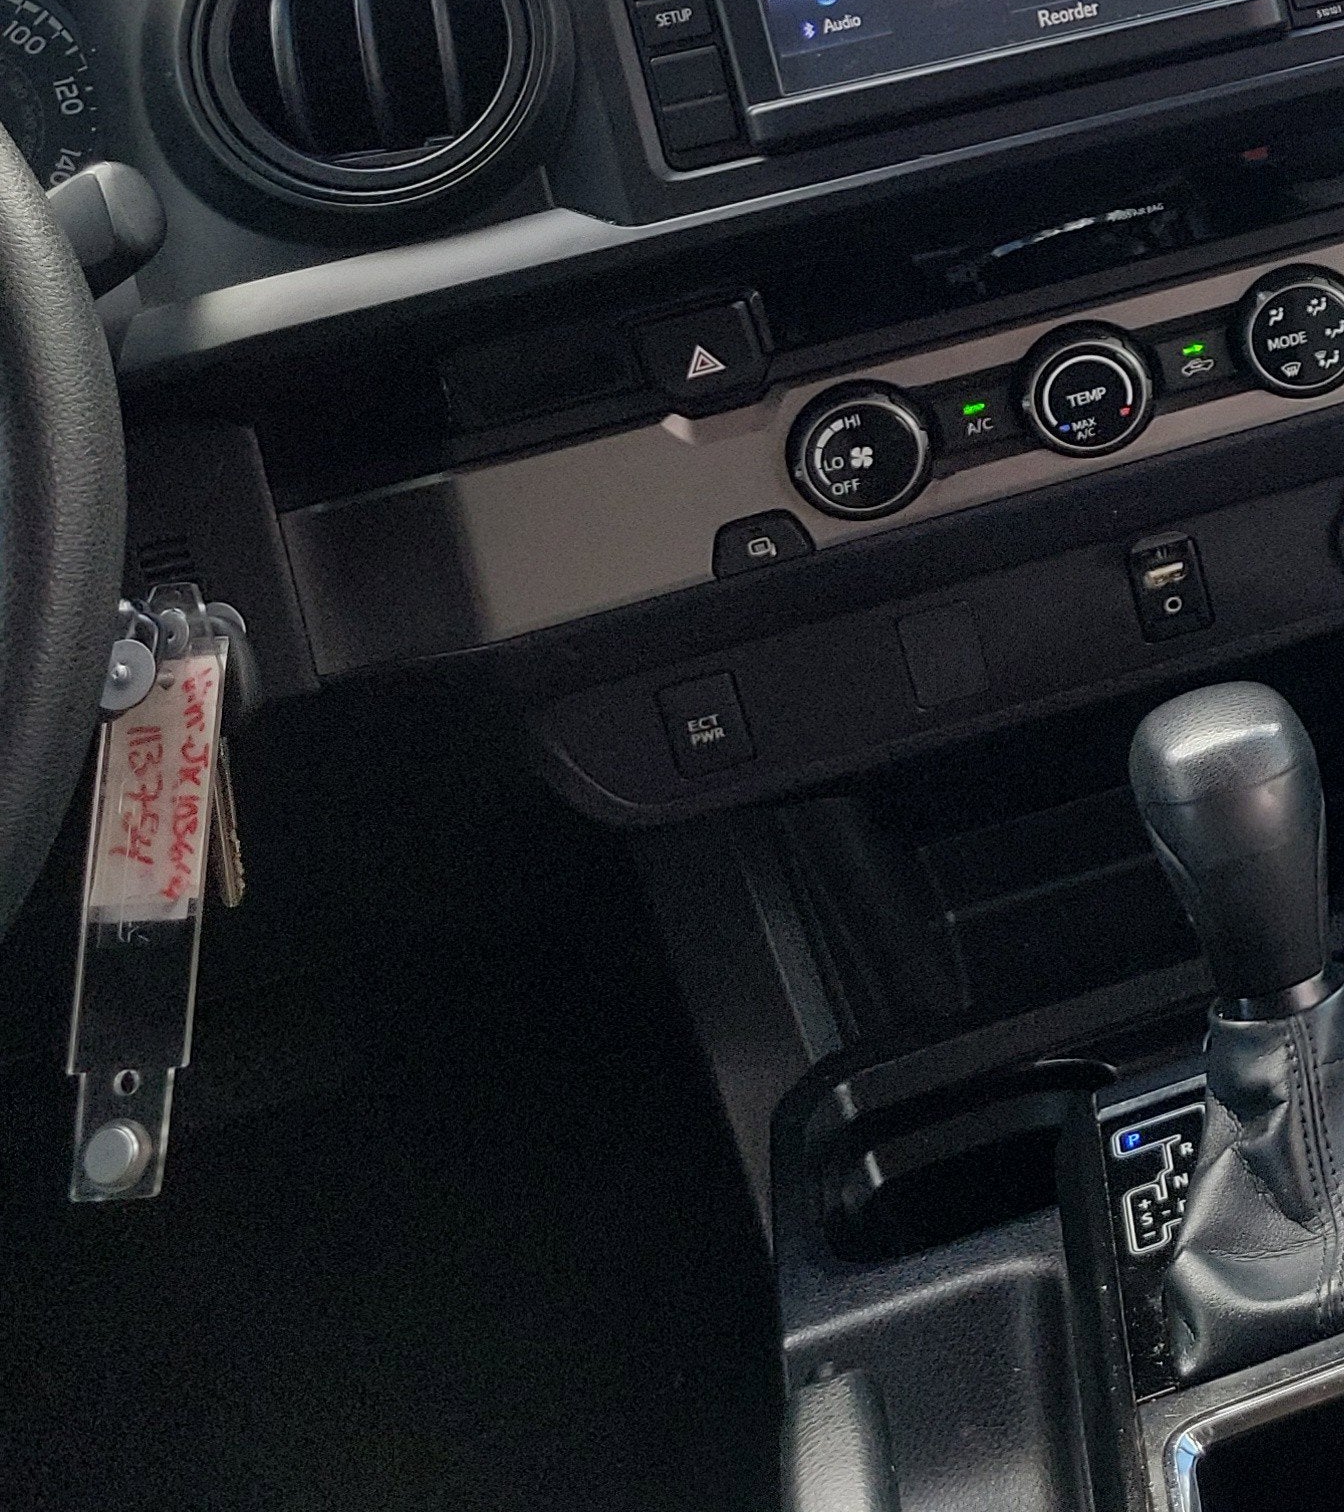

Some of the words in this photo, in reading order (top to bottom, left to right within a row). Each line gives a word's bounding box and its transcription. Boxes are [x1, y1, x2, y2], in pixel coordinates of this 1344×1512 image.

[655, 7, 693, 28] SETUP
[1037, 0, 1099, 28] Reorder
[823, 13, 861, 34] Audio
[2, 20, 46, 55] 100
[53, 76, 84, 115] 120
[1267, 331, 1309, 352] MODE
[1066, 386, 1107, 408] TEMP
[844, 413, 861, 430] HI
[966, 418, 994, 436] A/C
[1071, 417, 1097, 432] MAX
[1076, 426, 1097, 441] A/C
[823, 456, 845, 472] LO
[832, 478, 861, 496] OFF
[687, 714, 719, 732] ECT
[691, 727, 726, 746] PWR
[1126, 1133, 1141, 1148] P
[1179, 1141, 1194, 1157] R
[1172, 1172, 1190, 1189] N
[1140, 1212, 1154, 1226] S
